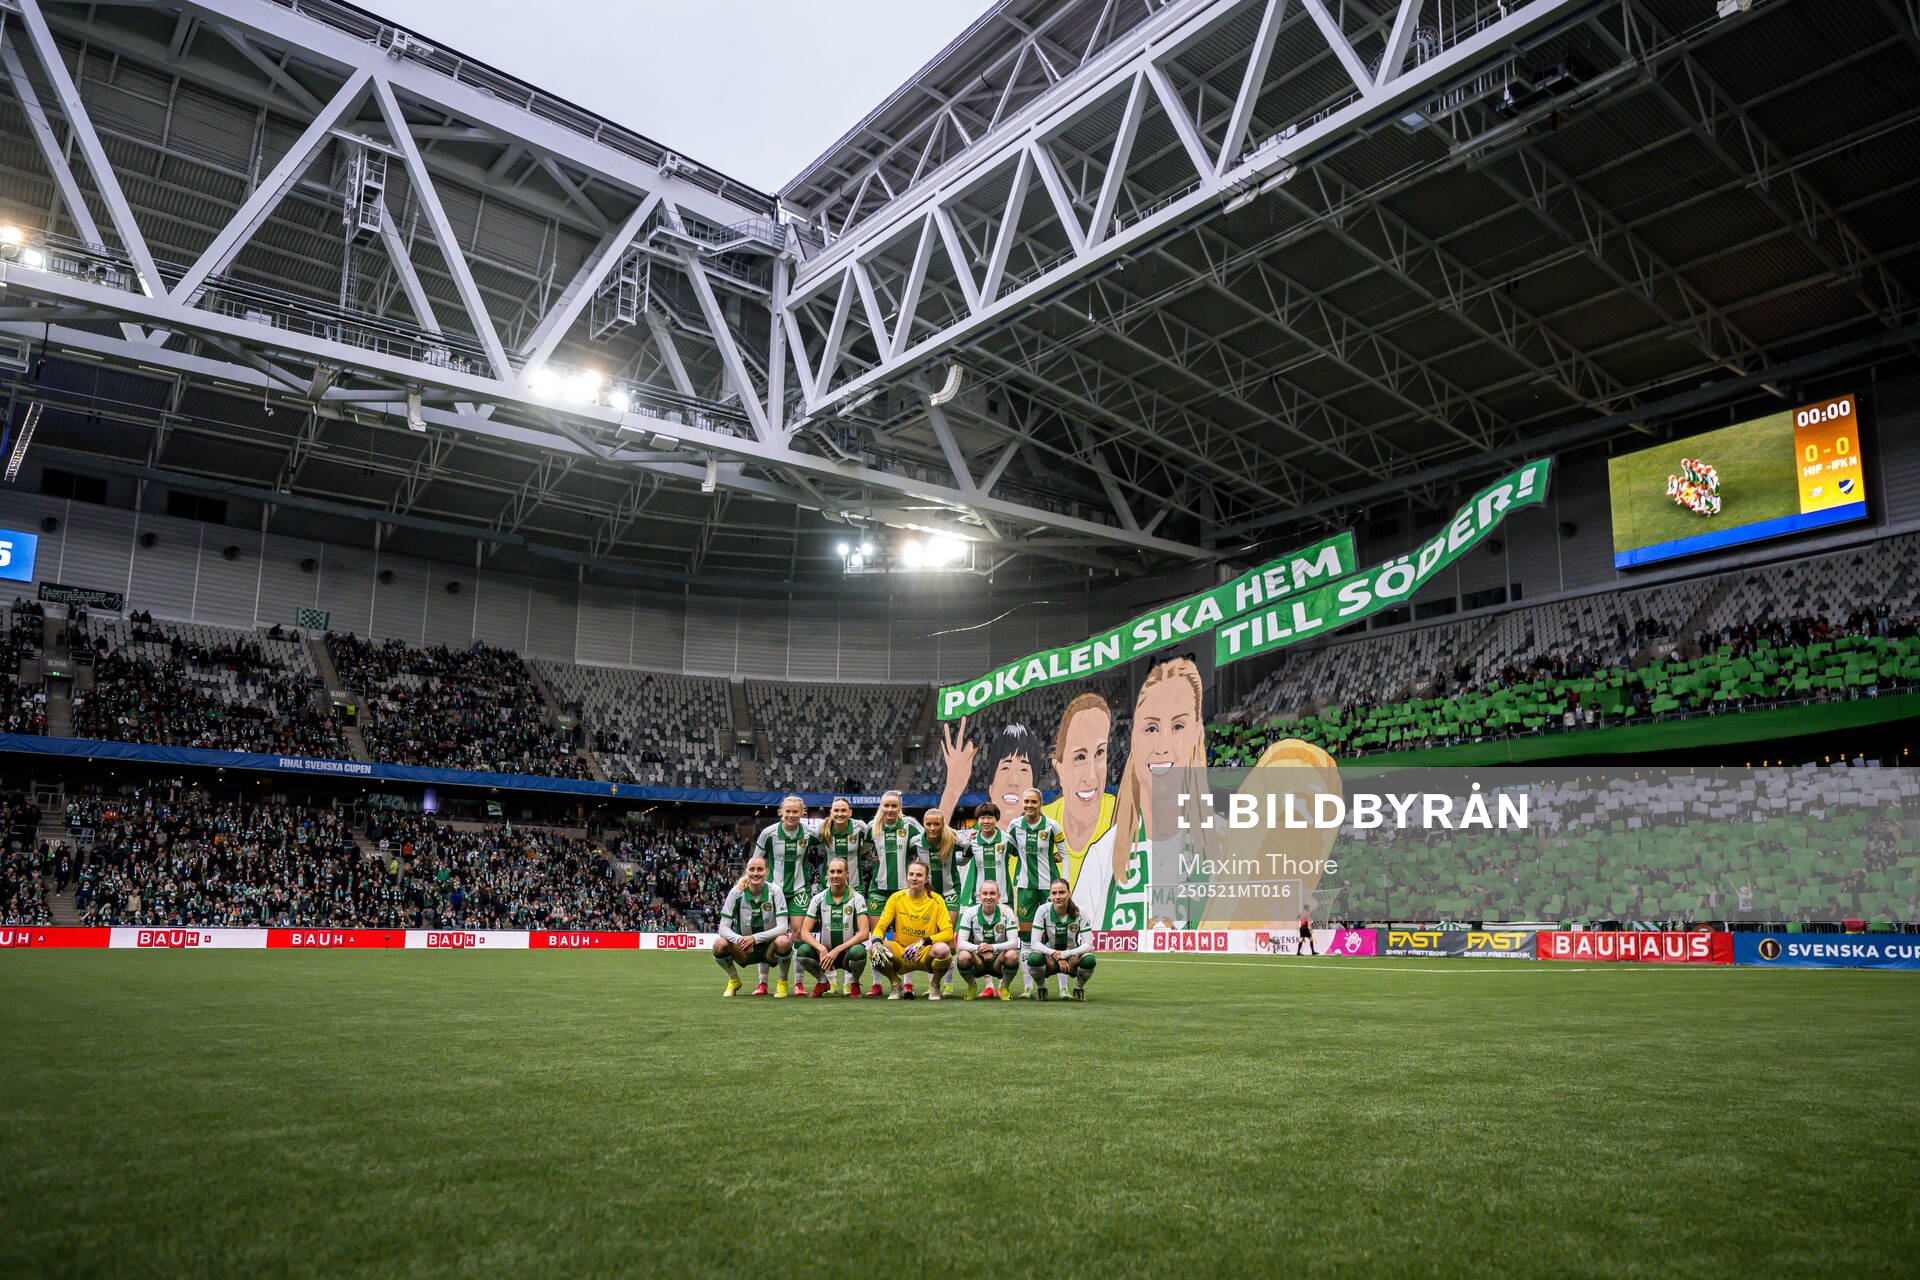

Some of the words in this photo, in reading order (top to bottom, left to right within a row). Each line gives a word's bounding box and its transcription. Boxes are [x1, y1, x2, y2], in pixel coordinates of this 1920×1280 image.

[1797, 400, 1851, 427] 00:00
[1805, 444, 1818, 463] 0
[1836, 436, 1849, 455] 0
[1221, 602, 1323, 654] TILL
[1338, 467, 1537, 617] SÖDER!
[944, 634, 1120, 715] POKALEN
[1133, 599, 1223, 652] SKA
[1235, 546, 1342, 612] HEM
[280, 758, 303, 769] FINAL
[305, 760, 343, 772] SVENSKA
[344, 763, 371, 774] CUPEN
[139, 930, 198, 947] BAUH
[292, 932, 343, 946] BAUH
[428, 932, 475, 948] BAUH
[549, 934, 590, 947] BAUH
[658, 934, 696, 949] BAUH
[1097, 932, 1138, 951] Finans
[1155, 933, 1227, 949] CRAMO
[1389, 932, 1443, 948] FAST
[1468, 932, 1527, 949] FAST
[1556, 935, 1709, 957] BAUHAUS
[1788, 944, 1880, 958] SVENSKA
